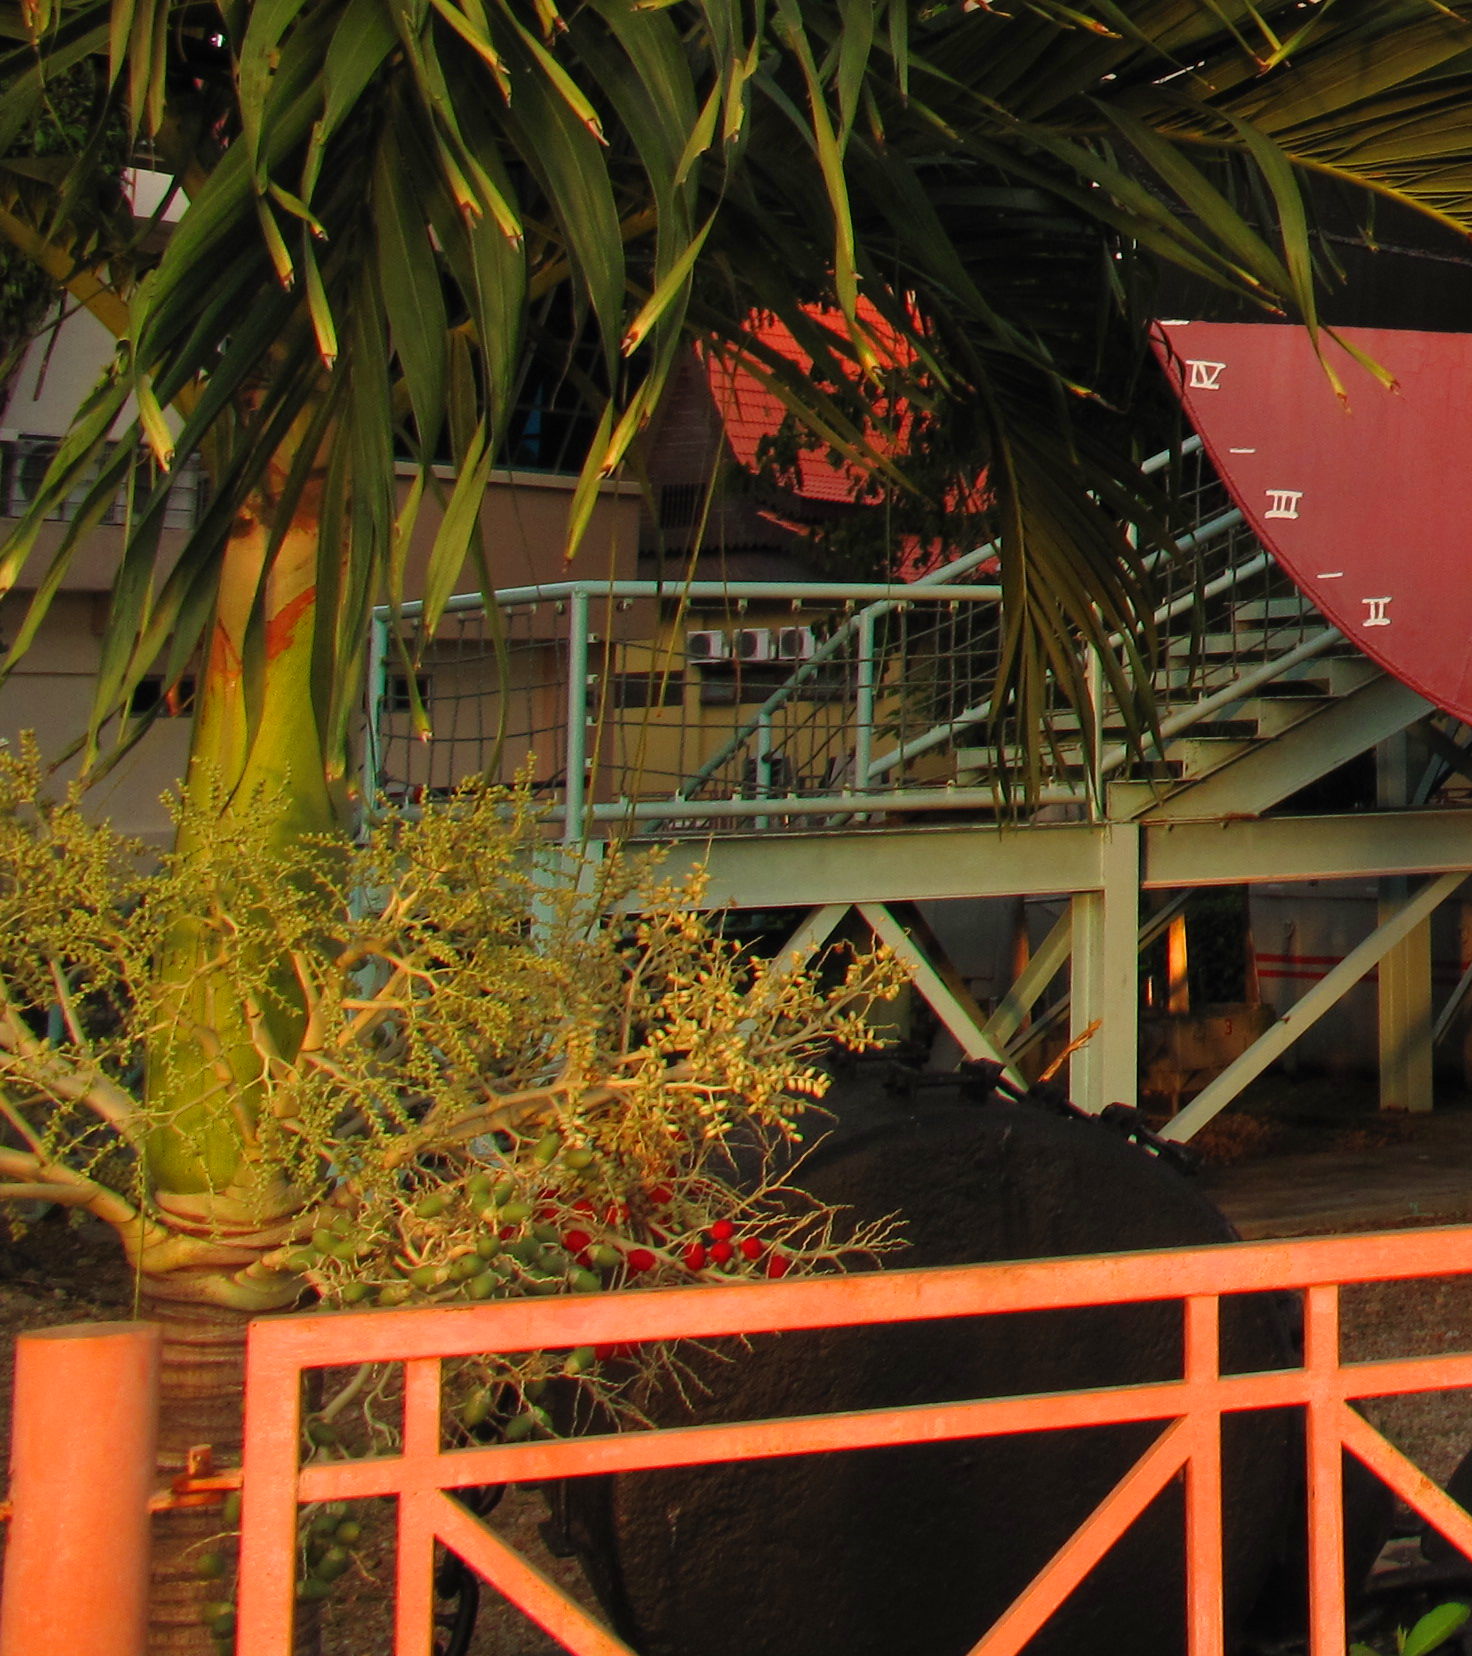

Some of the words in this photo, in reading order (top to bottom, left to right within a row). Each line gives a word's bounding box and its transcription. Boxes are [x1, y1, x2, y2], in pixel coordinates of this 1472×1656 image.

[1186, 359, 1226, 390] IV
[1264, 489, 1303, 519] III
[1361, 596, 1392, 626] II
